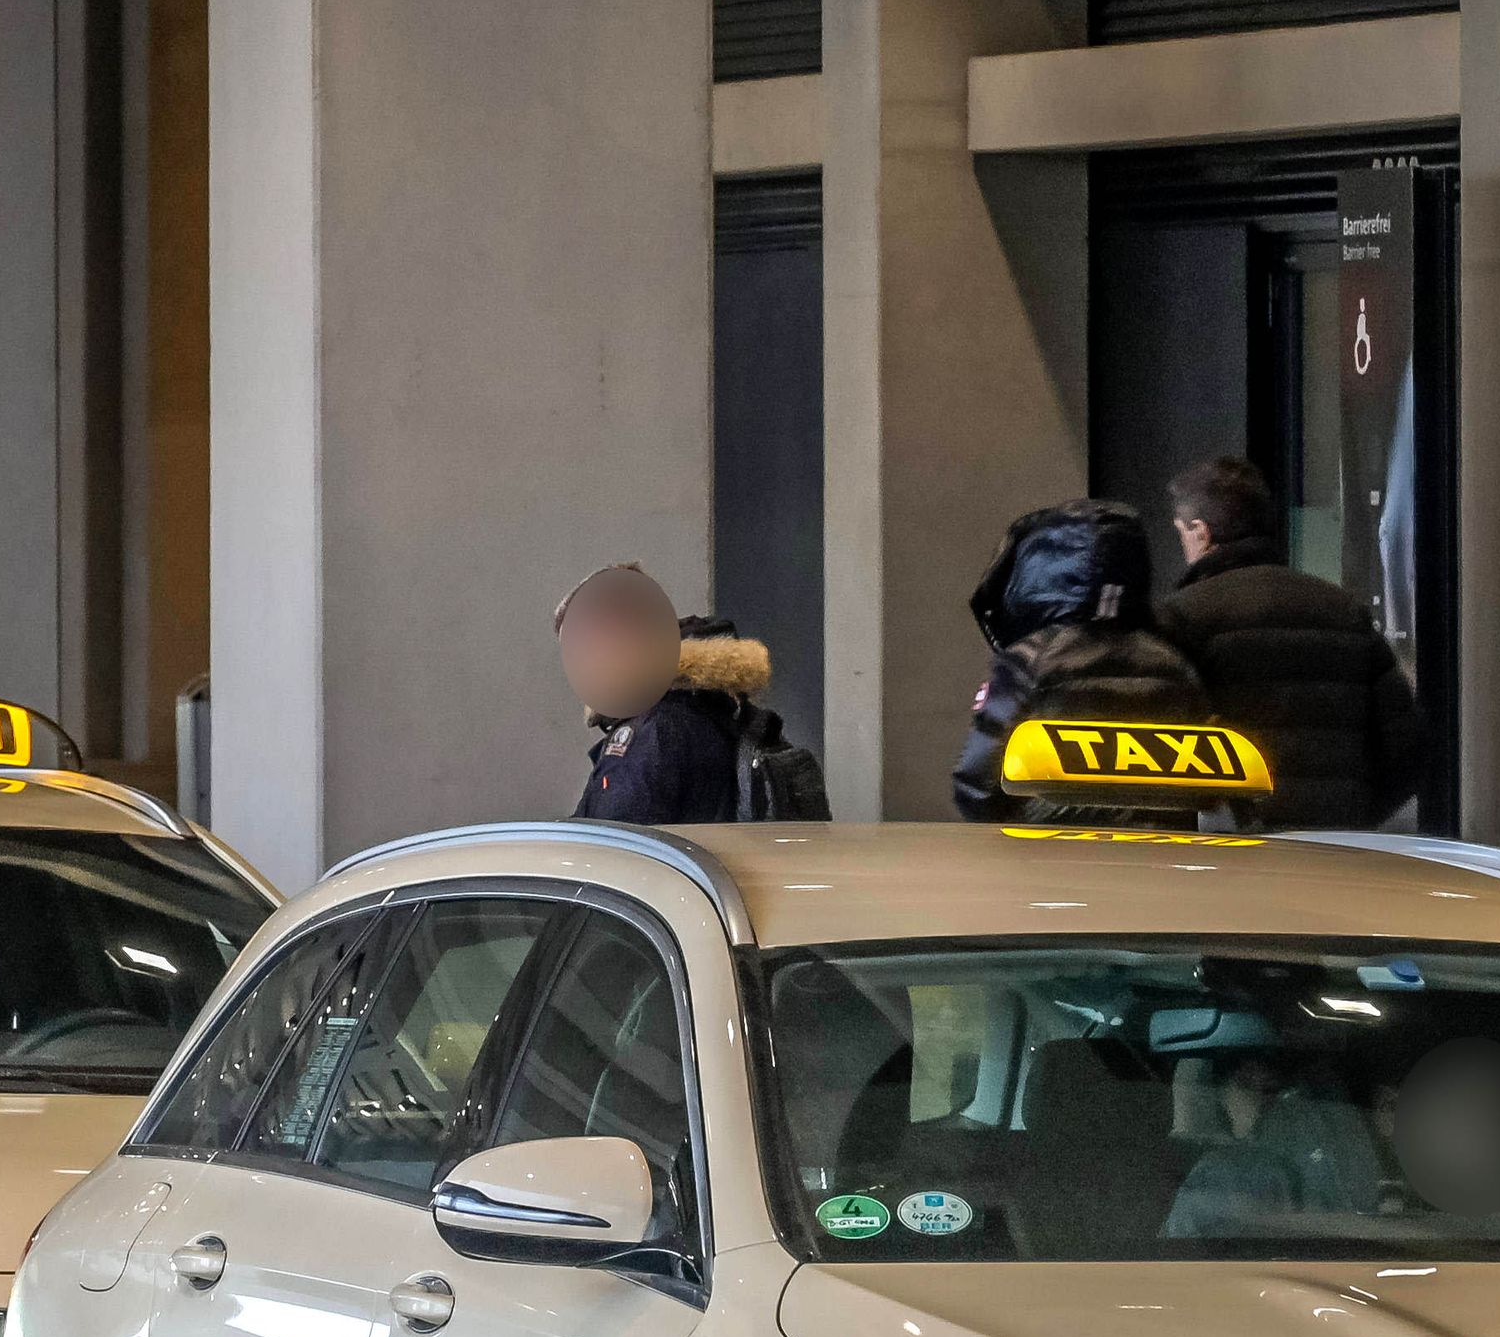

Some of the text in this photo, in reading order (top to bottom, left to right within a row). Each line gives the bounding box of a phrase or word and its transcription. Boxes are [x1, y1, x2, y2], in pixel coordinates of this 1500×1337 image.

[1343, 212, 1391, 235] Barrierefrei
[1057, 729, 1235, 774] TAXI
[842, 1199, 863, 1216] 4
